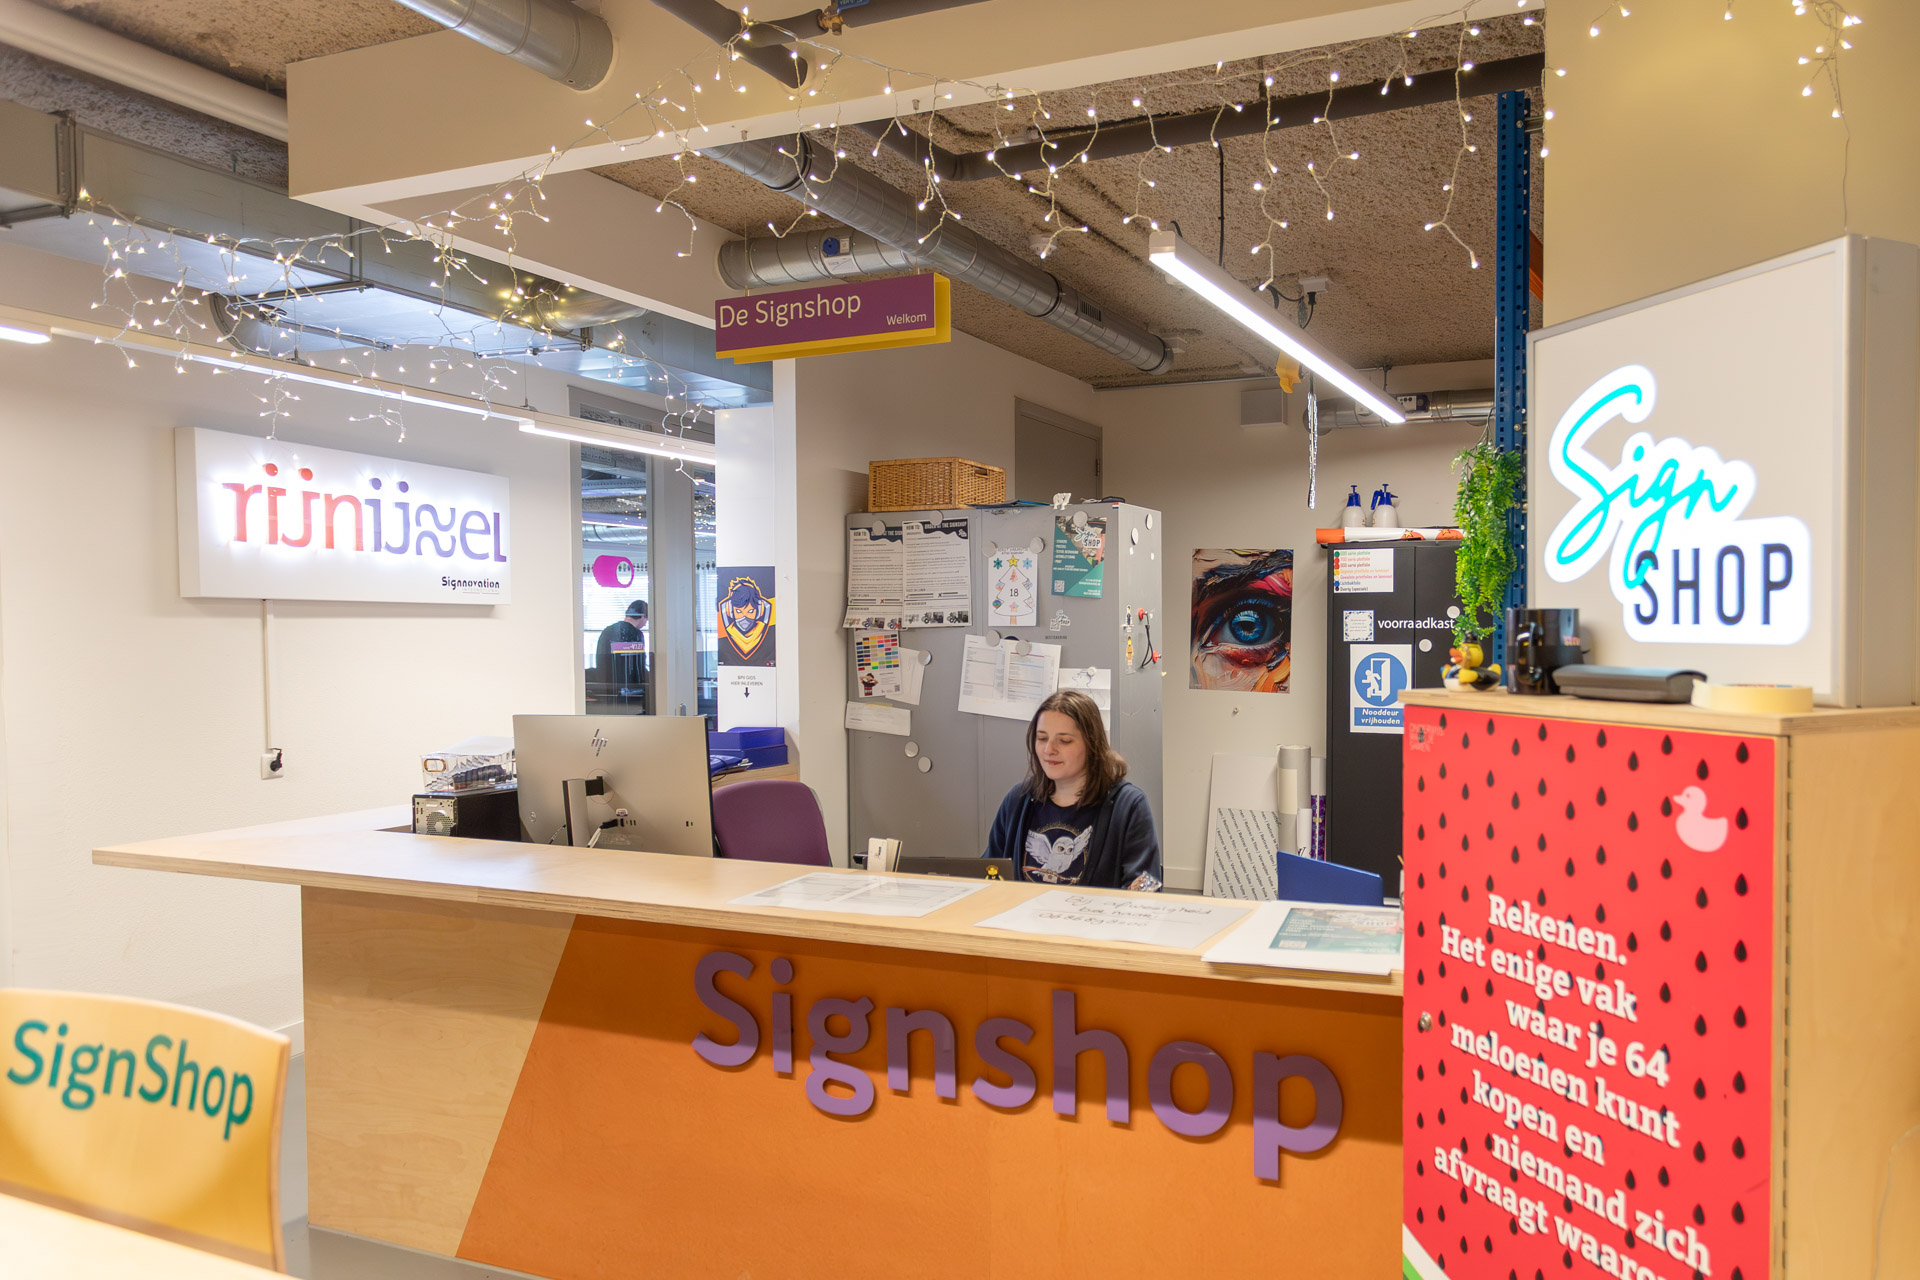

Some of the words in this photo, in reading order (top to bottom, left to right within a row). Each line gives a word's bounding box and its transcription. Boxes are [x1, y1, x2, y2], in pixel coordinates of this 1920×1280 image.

[720, 305, 748, 328] De
[755, 294, 862, 328] Signshop
[886, 313, 927, 326] Welkom
[1556, 384, 1738, 589] Sign
[442, 576, 500, 590] Signnovation
[1084, 538, 1100, 546] SHOP
[1634, 542, 1793, 626] SHOP
[1010, 588, 1018, 597] 18
[1378, 617, 1455, 629] voorraadkast
[1440, 924, 1486, 968] Het
[1490, 950, 1570, 1000] enige
[1576, 979, 1638, 1022] vak
[1488, 894, 1627, 966] Rekenen.
[7, 1020, 254, 1141] SignShop
[692, 950, 1344, 1182] Signshop
[1450, 1022, 1588, 1107] meloenen
[1594, 1076, 1681, 1148] kunt
[1505, 1000, 1581, 1051] waar
[1585, 1022, 1618, 1068] je
[1625, 1042, 1669, 1087] 64
[1472, 1069, 1558, 1142] kopen
[1564, 1124, 1606, 1166] en
[1434, 1146, 1550, 1235] afvraagt
[1492, 1133, 1627, 1230] niemand
[1635, 1210, 1712, 1277] zich
